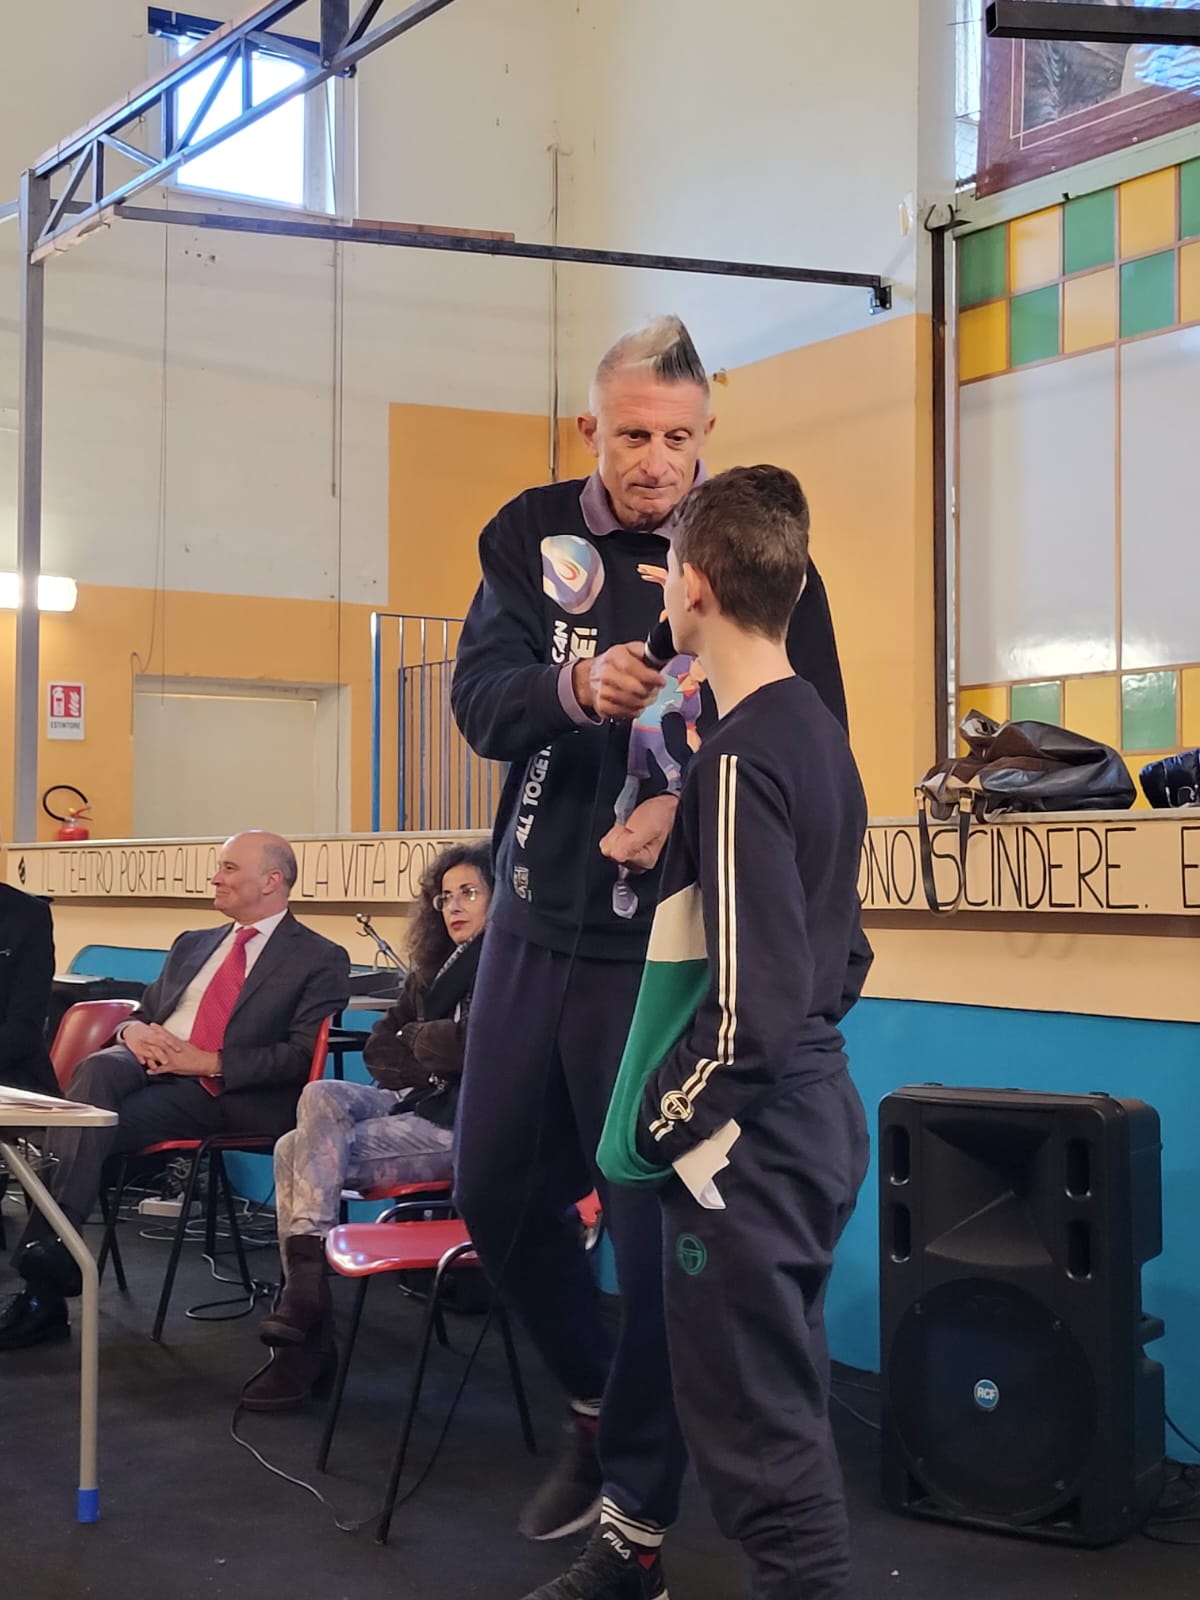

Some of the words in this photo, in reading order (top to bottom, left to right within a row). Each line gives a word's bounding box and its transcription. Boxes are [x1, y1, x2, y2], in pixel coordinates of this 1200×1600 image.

[515, 813, 535, 850] ALL
[551, 619, 568, 664] CAN
[58, 850, 114, 894] TEATRO
[120, 850, 167, 894] PORTA
[301, 842, 329, 898] LA
[341, 841, 387, 898] VITA
[977, 1386, 997, 1400] RCF
[602, 1530, 632, 1560] FILA
